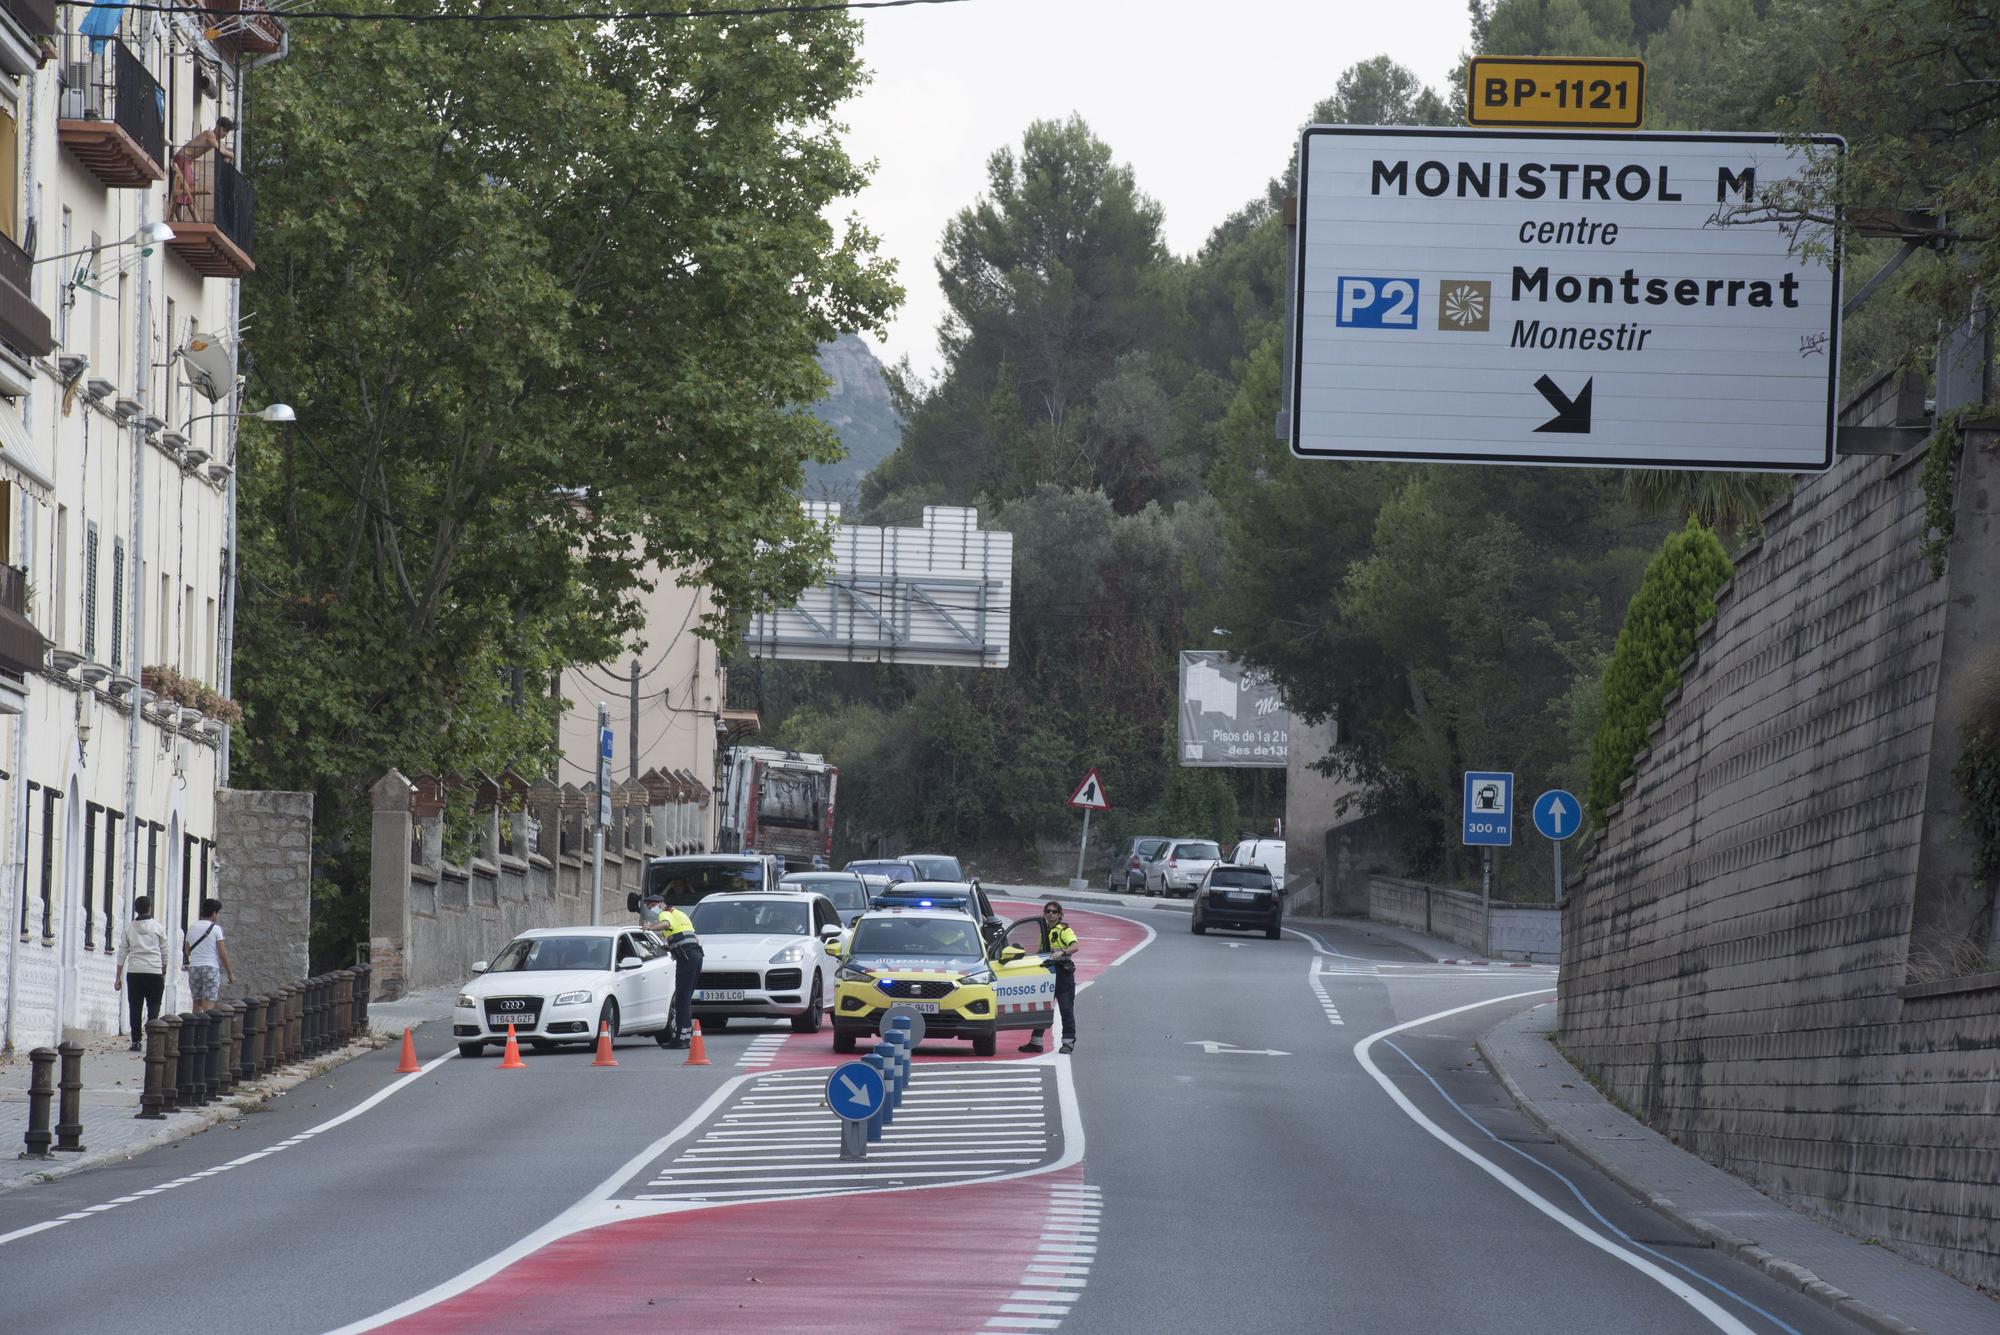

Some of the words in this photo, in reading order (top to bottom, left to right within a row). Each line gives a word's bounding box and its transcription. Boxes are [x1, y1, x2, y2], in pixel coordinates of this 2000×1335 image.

[1484, 77, 1629, 110] BP-1121
[1371, 159, 1683, 203] MONISTROL
[1518, 216, 1619, 247] centre
[1341, 278, 1416, 325] P2
[1511, 266, 1801, 309] Montserrat
[1510, 318, 1653, 352] Monestir
[1213, 729, 1240, 742] Pisos
[1242, 730, 1254, 742] de
[1273, 730, 1279, 742] 2
[1229, 745, 1250, 756] des
[1468, 823, 1493, 833] 300
[1497, 826, 1507, 834] m
[705, 991, 725, 1000] 3136
[997, 984, 1036, 997] mossos
